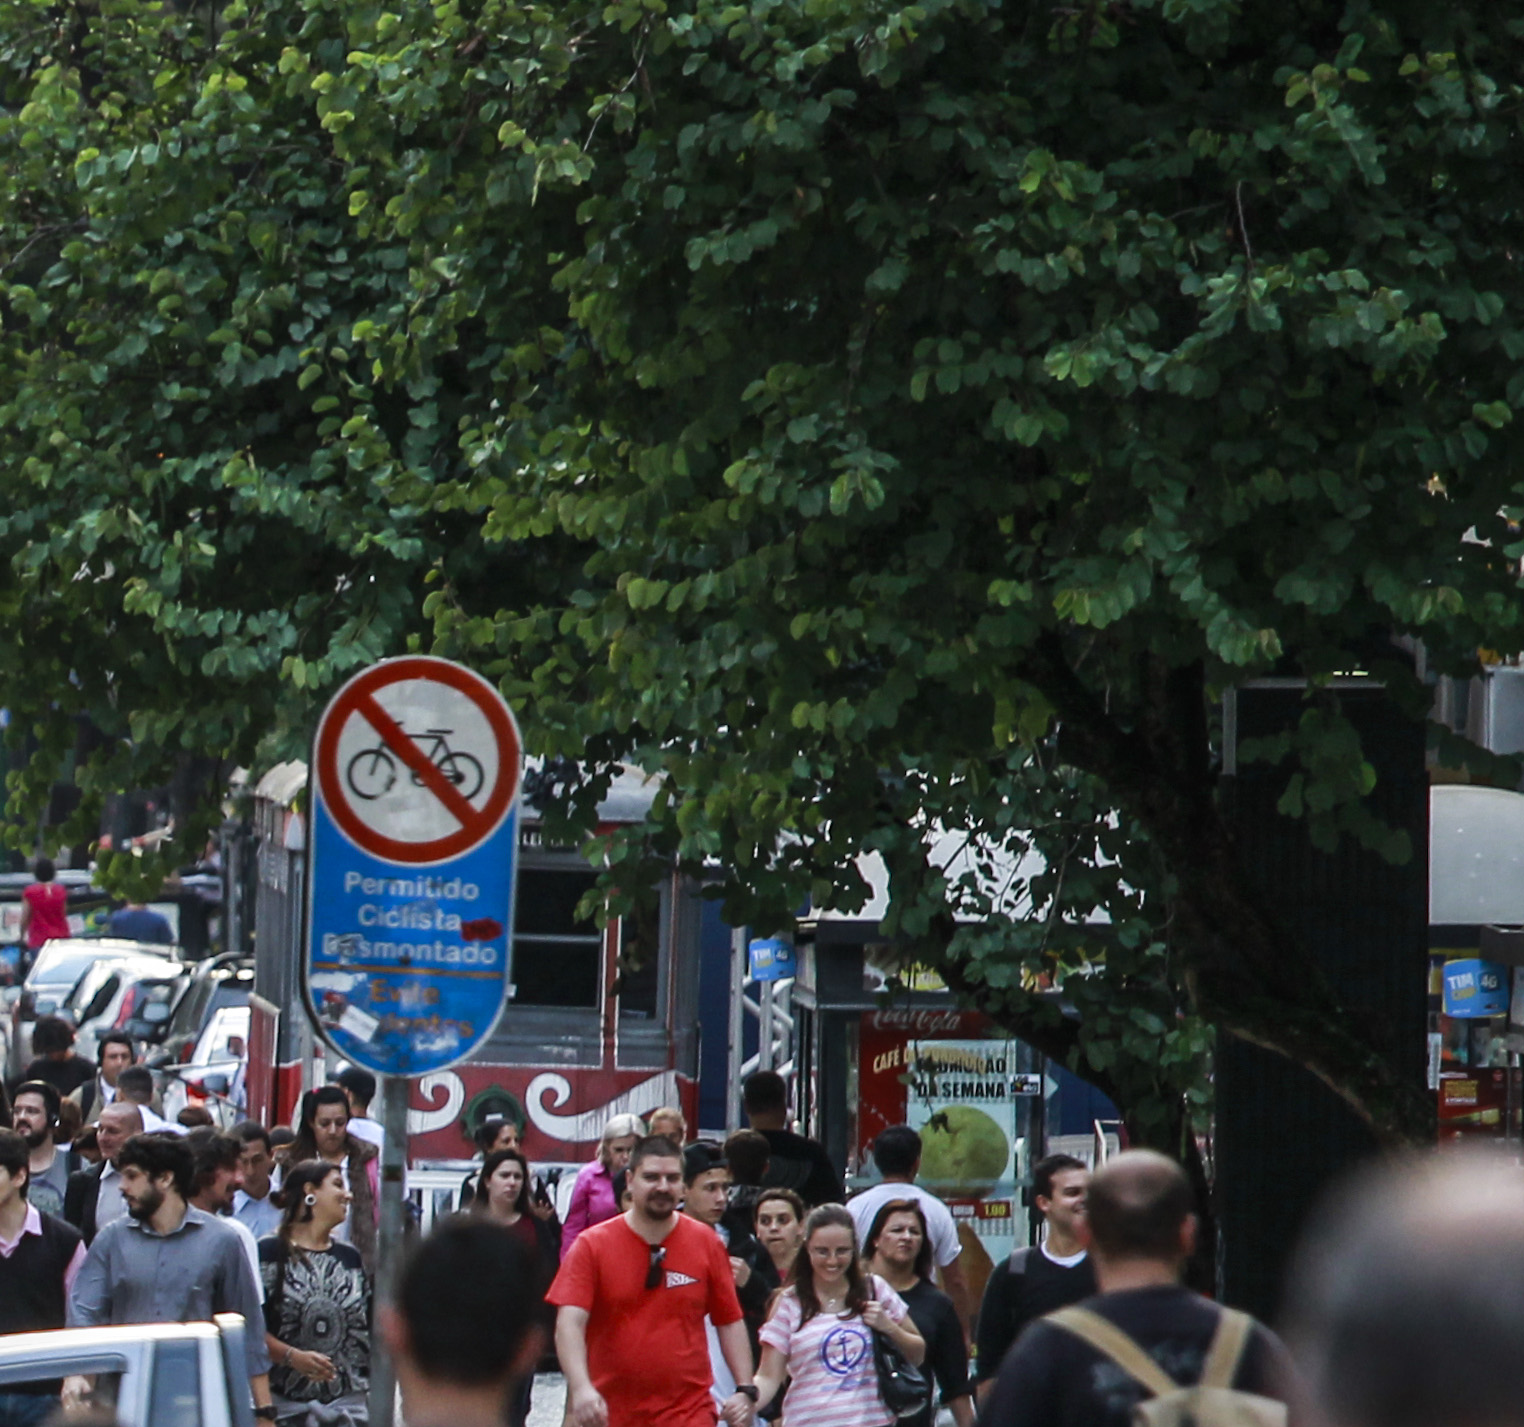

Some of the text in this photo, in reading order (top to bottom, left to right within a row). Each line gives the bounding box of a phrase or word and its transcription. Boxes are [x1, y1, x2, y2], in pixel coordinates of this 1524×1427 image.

[344, 871, 480, 901] Permitido
[358, 903, 462, 932] Ciclista
[1447, 972, 1474, 990] TIM
[1480, 973, 1498, 989] 4G
[873, 1044, 900, 1075] CAFÉ
[942, 1082, 1007, 1099] SEMANA
